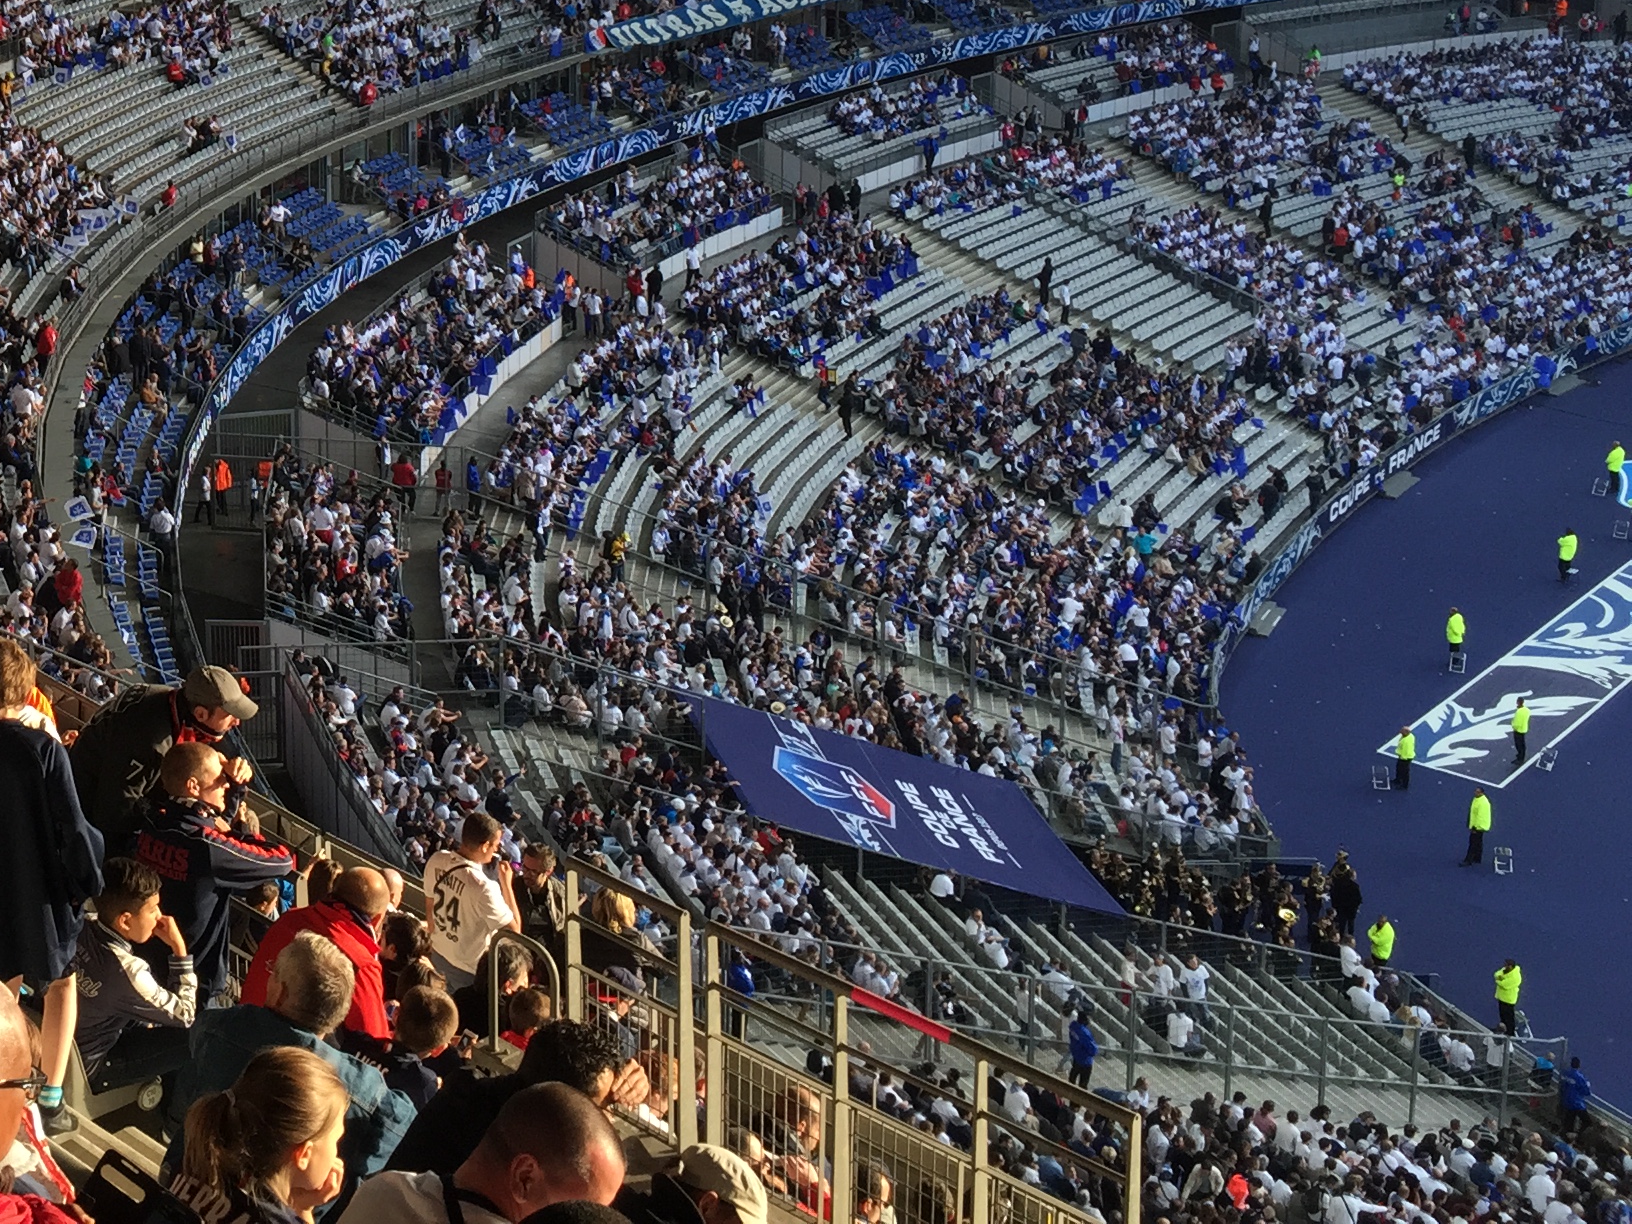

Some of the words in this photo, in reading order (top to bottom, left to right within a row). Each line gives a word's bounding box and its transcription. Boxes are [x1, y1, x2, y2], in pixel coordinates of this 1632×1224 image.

[609, 3, 728, 48] ULTRAS
[1329, 473, 1371, 523] COUPE
[1388, 422, 1442, 474] FRANCE
[840, 770, 888, 820] FFF
[894, 779, 961, 849] COUPE
[929, 785, 1005, 865] FRANCE
[934, 810, 958, 831] DE
[433, 886, 460, 933] 24
